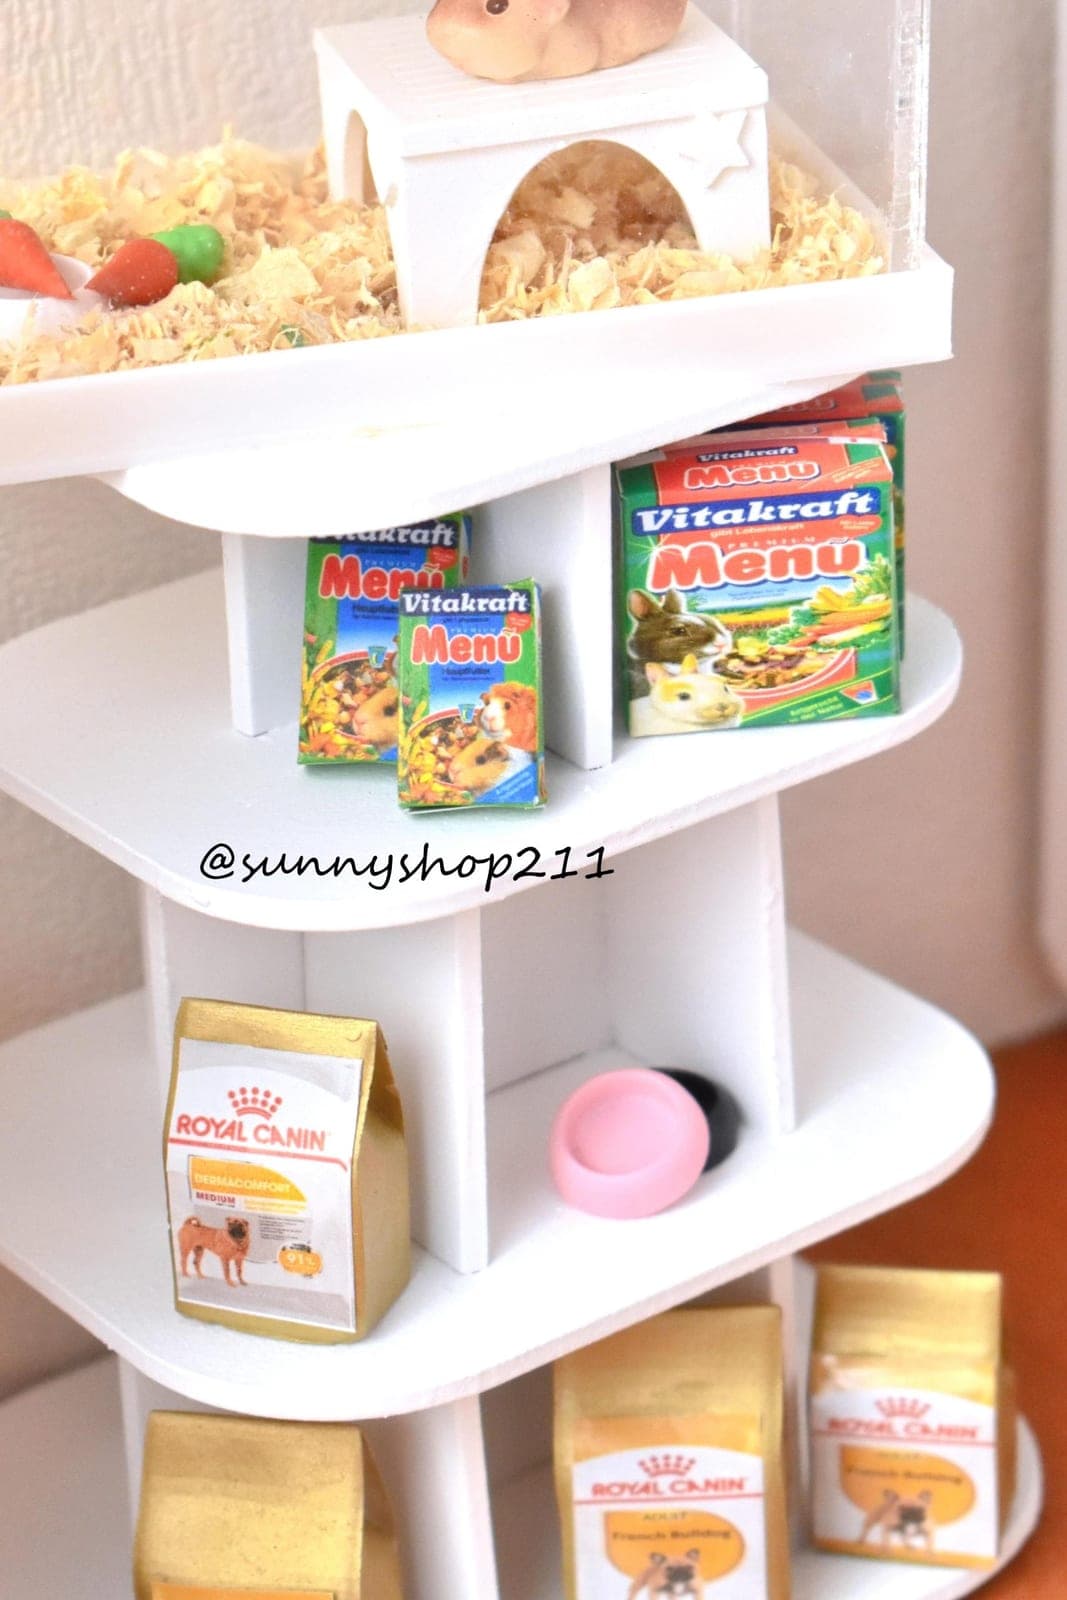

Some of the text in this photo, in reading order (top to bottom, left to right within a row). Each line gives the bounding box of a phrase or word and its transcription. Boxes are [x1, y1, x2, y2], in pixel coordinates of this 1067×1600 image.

[699, 446, 796, 462] Vitakraft
[637, 492, 875, 532] Vitakraft
[402, 591, 529, 613] Vitakraft
[176, 1113, 326, 1151] ROYAL CANIN
[194, 1173, 290, 1193] DERMACOMFORT
[196, 1191, 236, 1205] MEDIUM
[827, 1417, 978, 1439] ROYAL CANIN
[591, 1477, 745, 1496] ROYAL CANIN
